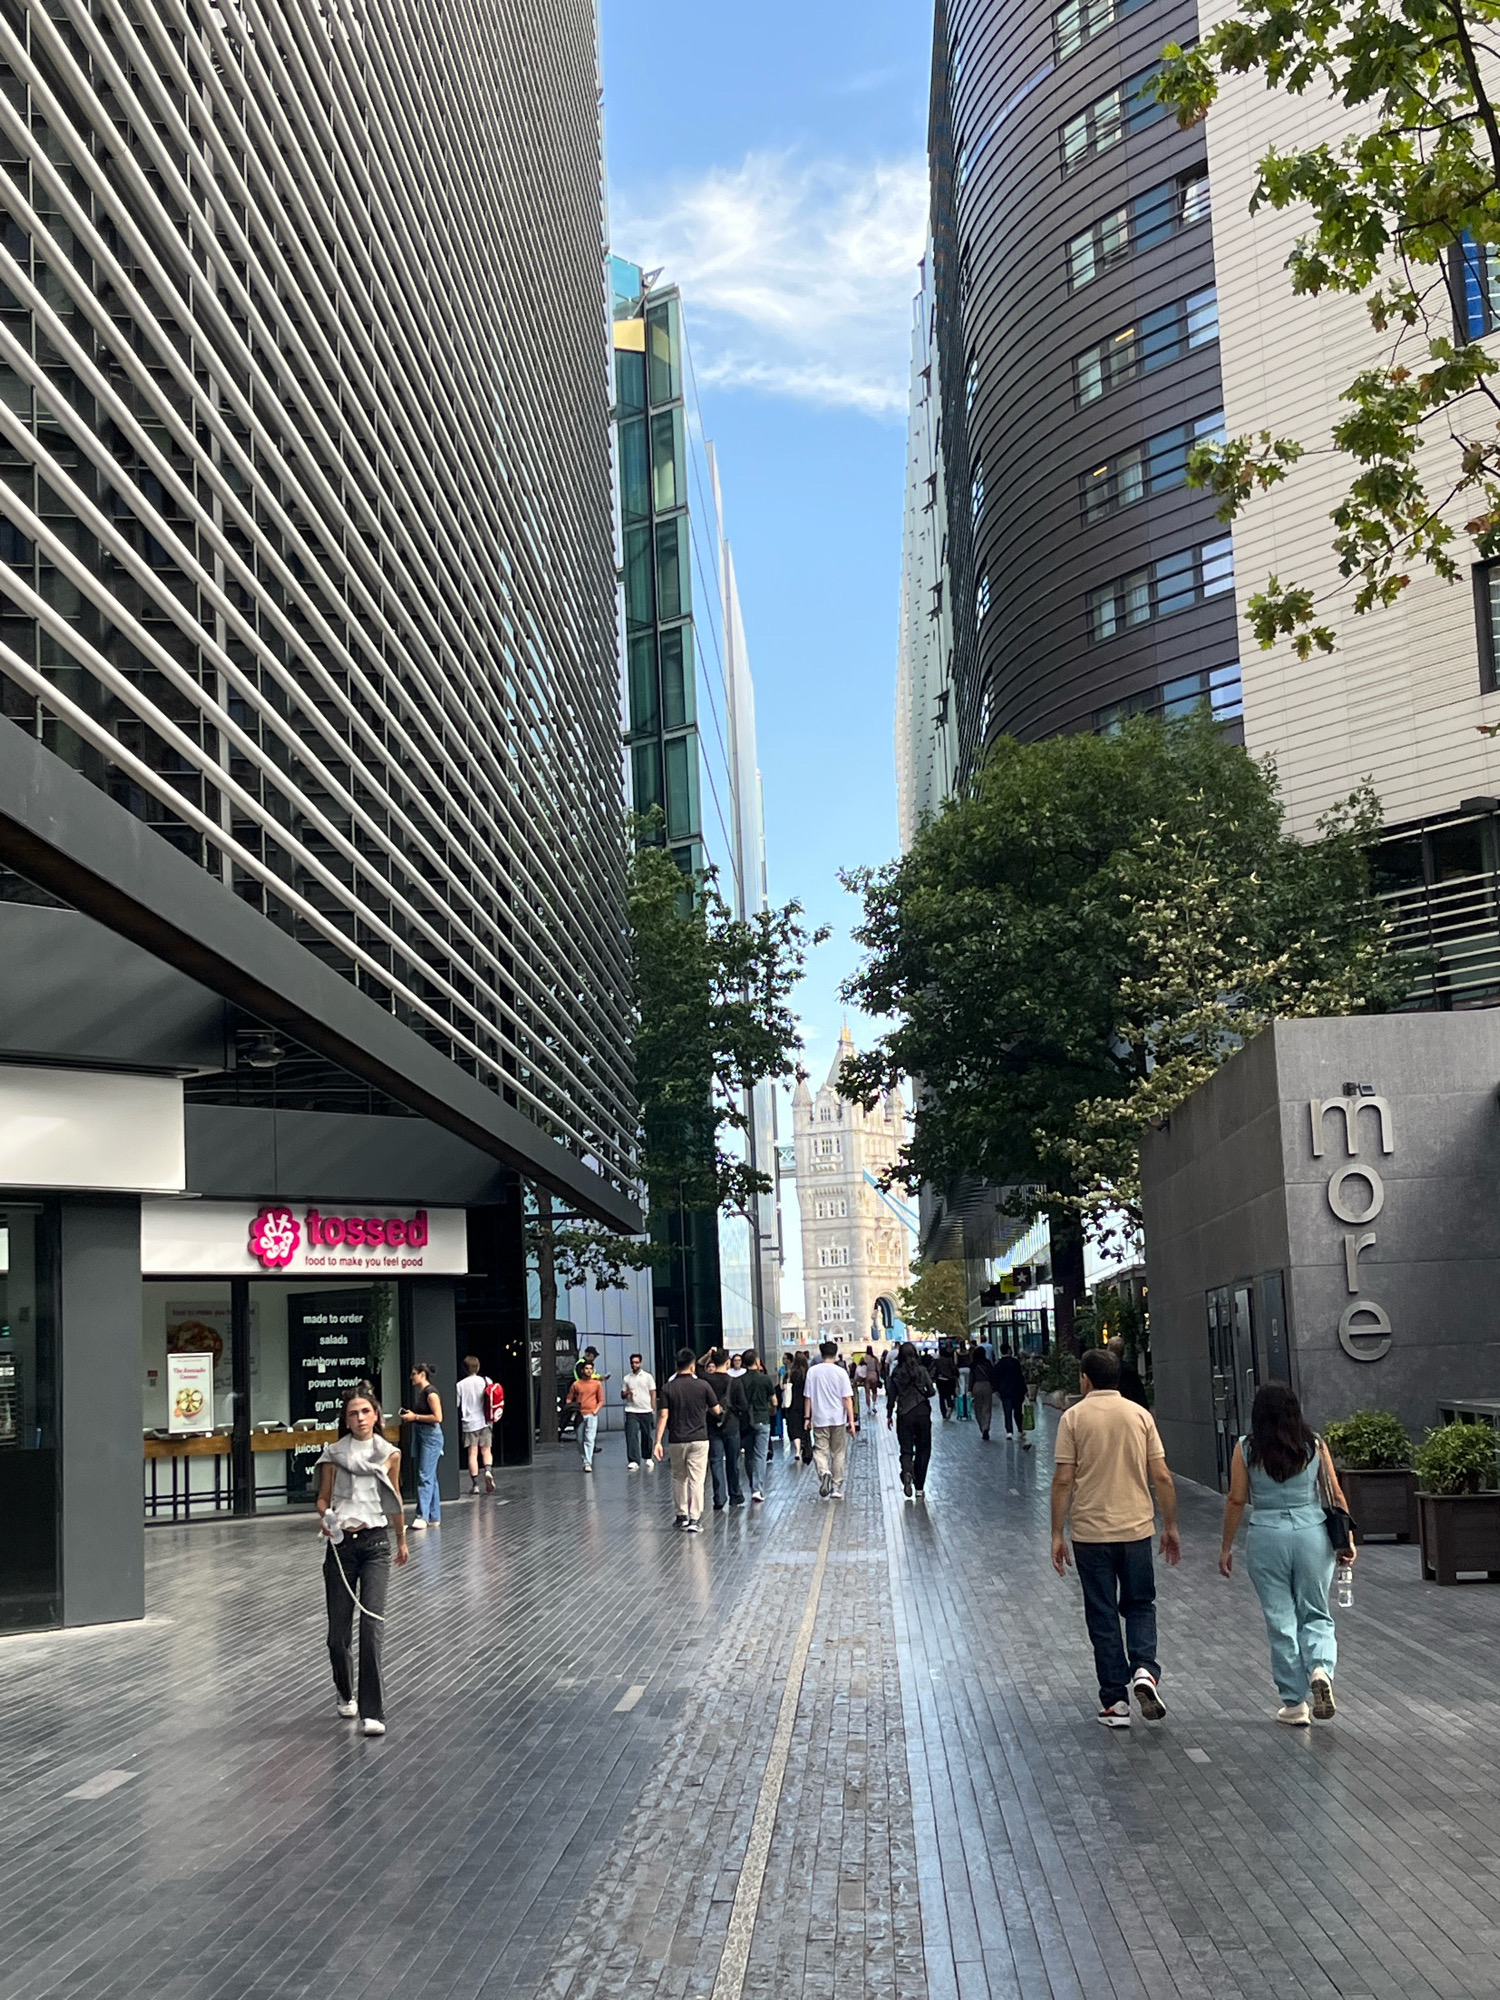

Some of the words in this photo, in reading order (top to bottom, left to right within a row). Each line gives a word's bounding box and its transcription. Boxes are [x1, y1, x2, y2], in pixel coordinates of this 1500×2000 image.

[305, 1209, 428, 1247] tossed
[1310, 1096, 1394, 1362] more
[305, 1256, 326, 1266] food
[328, 1256, 337, 1266] to
[339, 1256, 363, 1266] make
[365, 1257, 381, 1268] you
[383, 1256, 399, 1266] feel
[401, 1257, 423, 1269] good
[303, 1313, 328, 1324] made
[329, 1313, 338, 1324] to
[339, 1313, 364, 1324] order
[319, 1334, 348, 1345] salads
[302, 1356, 338, 1367] rainbow
[339, 1357, 366, 1368] wraps
[308, 1379, 336, 1391] power
[315, 1400, 334, 1412] gym
[294, 1443, 321, 1456] juices
